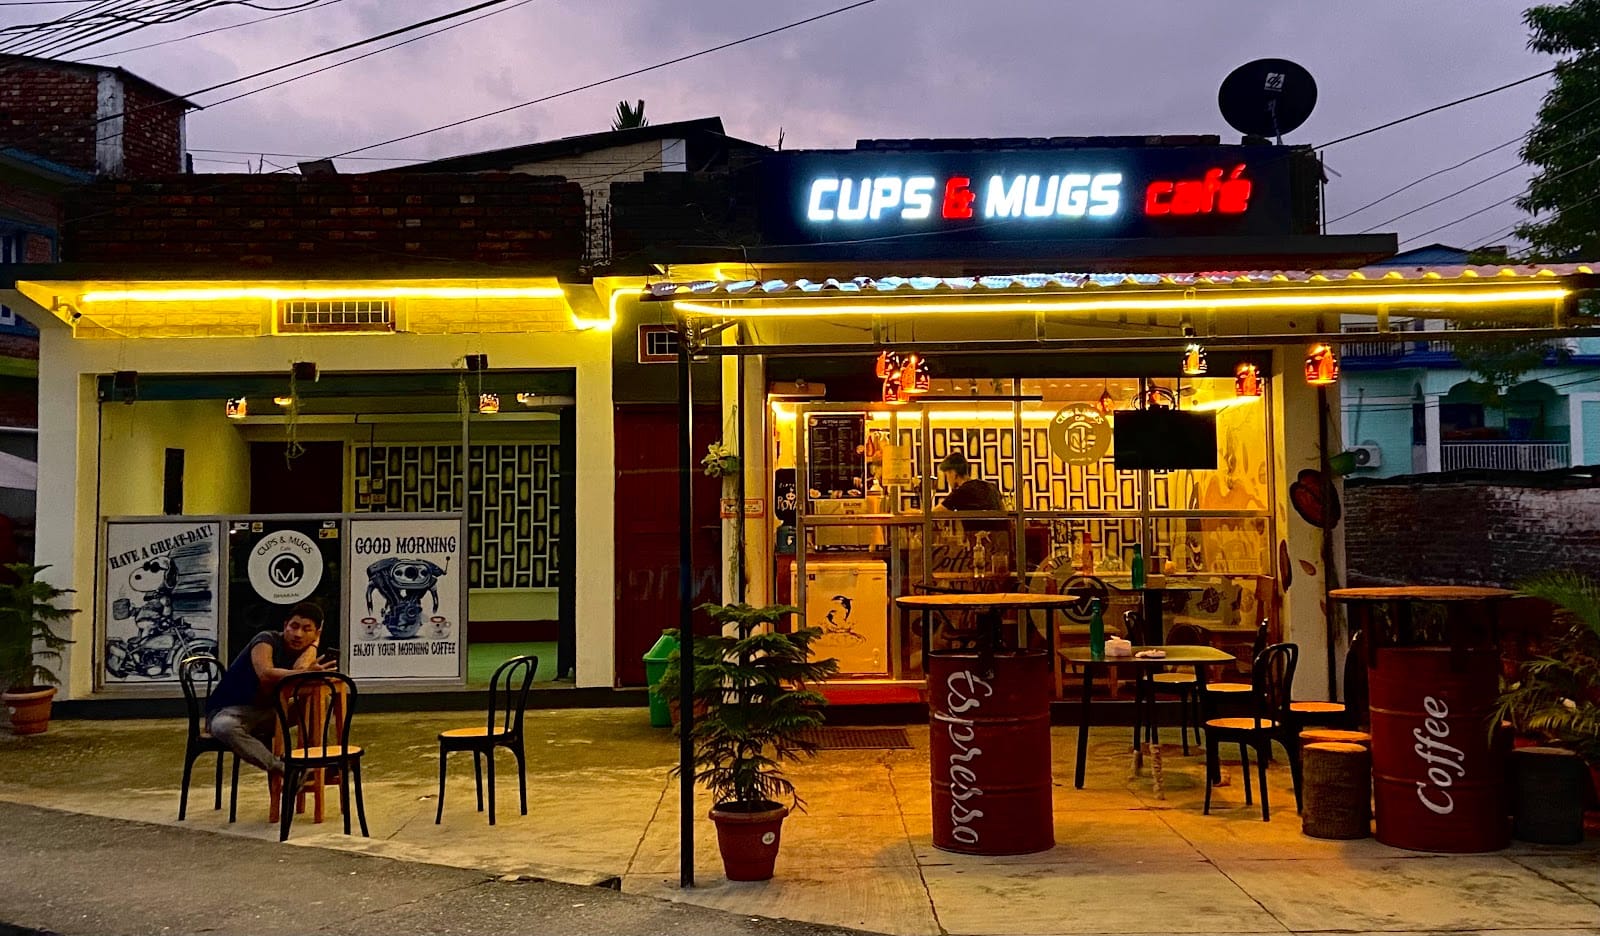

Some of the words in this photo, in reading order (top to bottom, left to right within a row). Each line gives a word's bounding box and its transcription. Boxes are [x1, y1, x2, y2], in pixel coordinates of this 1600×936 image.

[807, 177, 937, 221] CUPS
[942, 177, 976, 219] &
[984, 173, 1124, 219] MUGS
[257, 538, 278, 556] CUPS
[280, 536, 286, 544] &
[289, 536, 313, 555] MUGS
[355, 537, 391, 555] GOOD
[396, 536, 456, 554] MORNING
[109, 549, 140, 569] HAVE
[141, 547, 149, 559] A
[353, 644, 375, 656] ENJOY
[377, 643, 396, 656] YOUR
[398, 642, 429, 655] MORNING
[431, 641, 455, 654] COFFEE
[1413, 696, 1465, 815] Coffee
